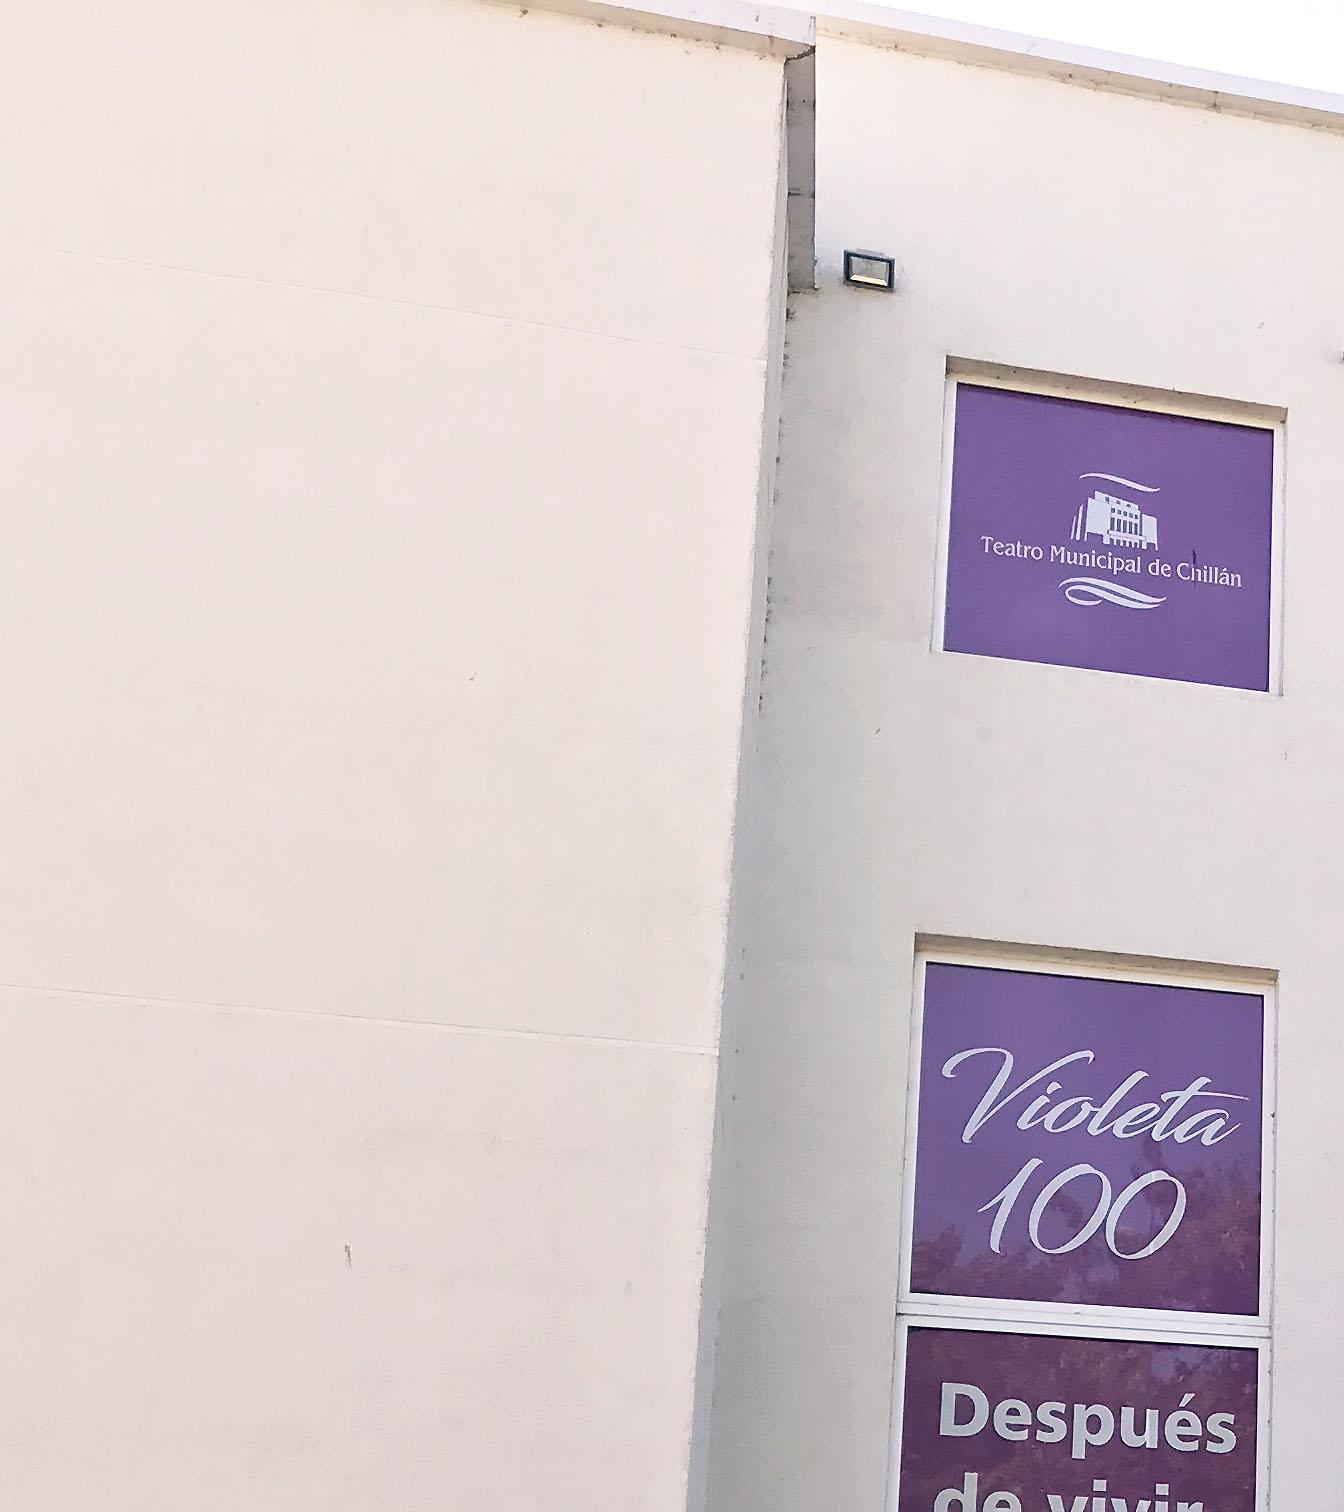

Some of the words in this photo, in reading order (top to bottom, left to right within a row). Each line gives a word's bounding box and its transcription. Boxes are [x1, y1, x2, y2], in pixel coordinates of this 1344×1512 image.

[980, 535, 1044, 561] Teatro
[1050, 545, 1142, 575] Municipal
[1148, 558, 1172, 578] de
[1176, 561, 1243, 588] Chillán
[941, 1046, 1250, 1147] Violeta
[977, 1157, 1187, 1260] 100
[939, 1381, 1237, 1459] Después
